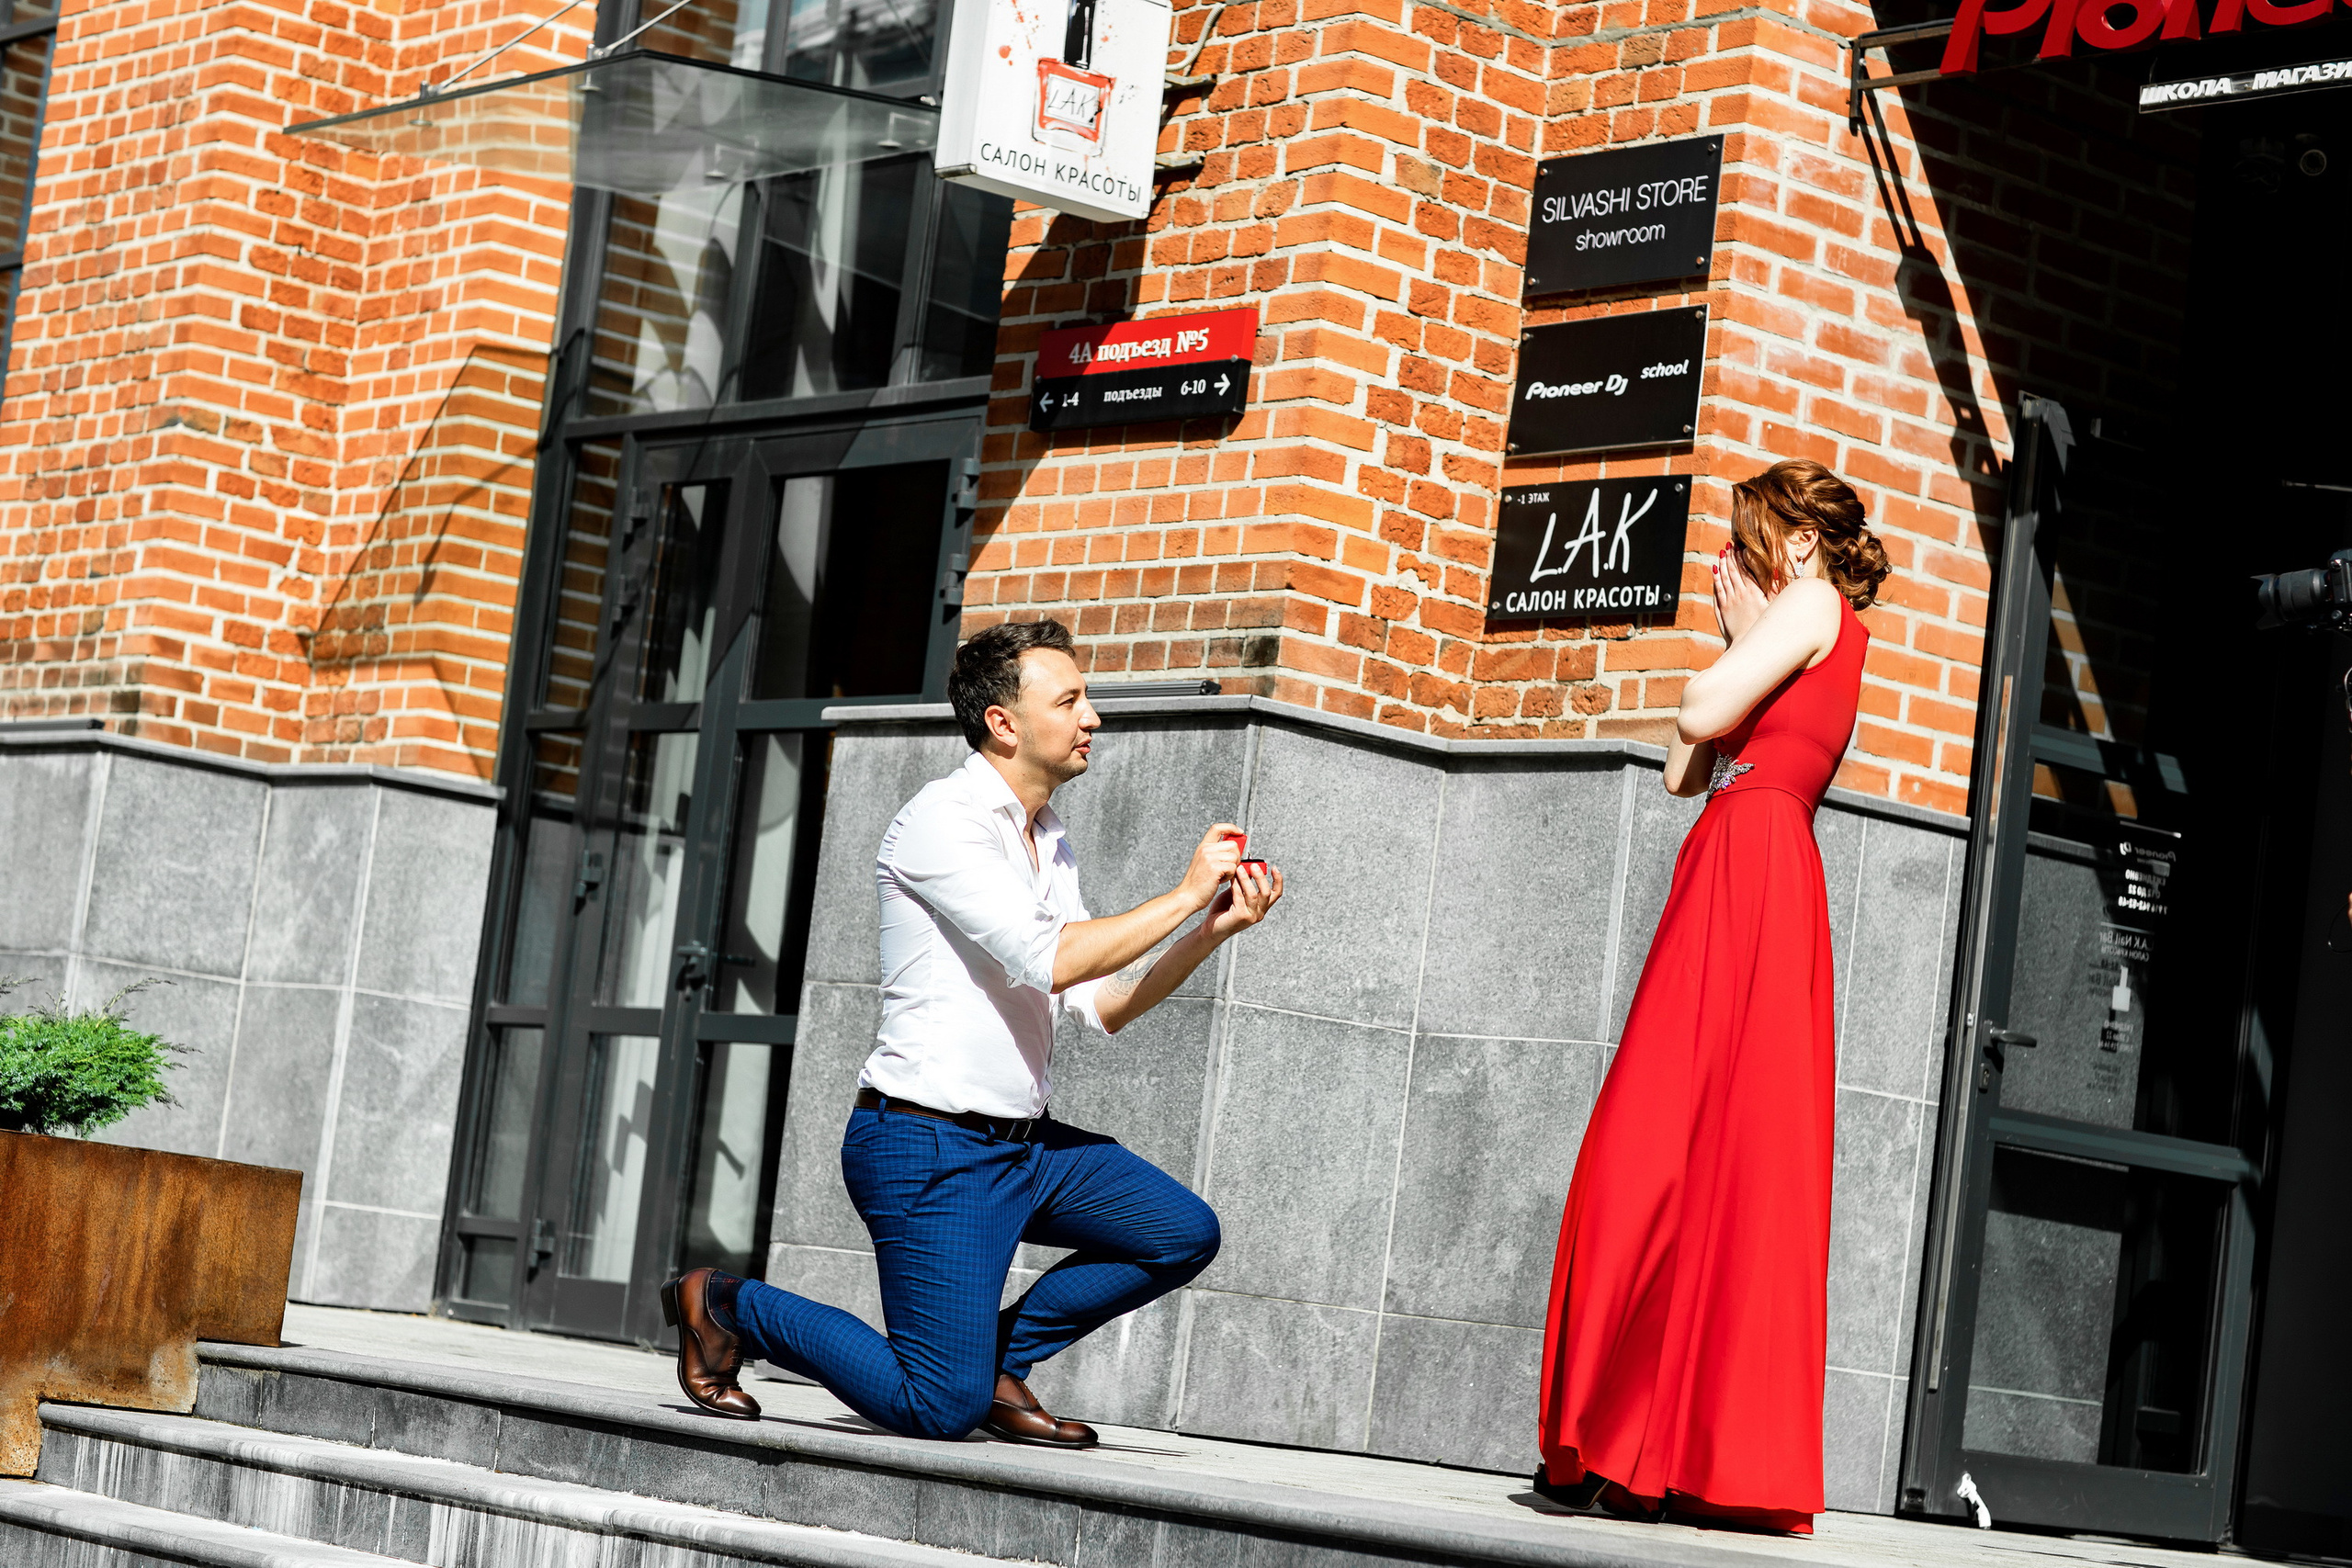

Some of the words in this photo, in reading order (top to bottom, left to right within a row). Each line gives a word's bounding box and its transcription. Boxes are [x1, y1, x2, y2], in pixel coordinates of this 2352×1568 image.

[2139, 77, 2233, 104] ШКОЛА
[980, 143, 1046, 175] САЛОН
[1055, 163, 1141, 203] КРАСОТЫ
[1542, 186, 1631, 223] SILVASHI
[1636, 175, 1709, 210] STORE
[1575, 223, 1666, 252] showroom
[1069, 341, 1092, 364] 4А
[1097, 337, 1171, 364] подъезд
[1174, 327, 1210, 354] №5
[1062, 391, 1080, 408] 1-4
[1103, 387, 1163, 404] подъезды
[1181, 378, 1206, 396] 6-10
[1525, 380, 1603, 400] Pioneer
[1640, 359, 1690, 379] school
[1517, 493, 1525, 505] -1
[1527, 491, 1551, 504] ЭТАЖ
[1506, 590, 1566, 613] САЛОН
[1573, 584, 1660, 609] КРАСОТЫ
